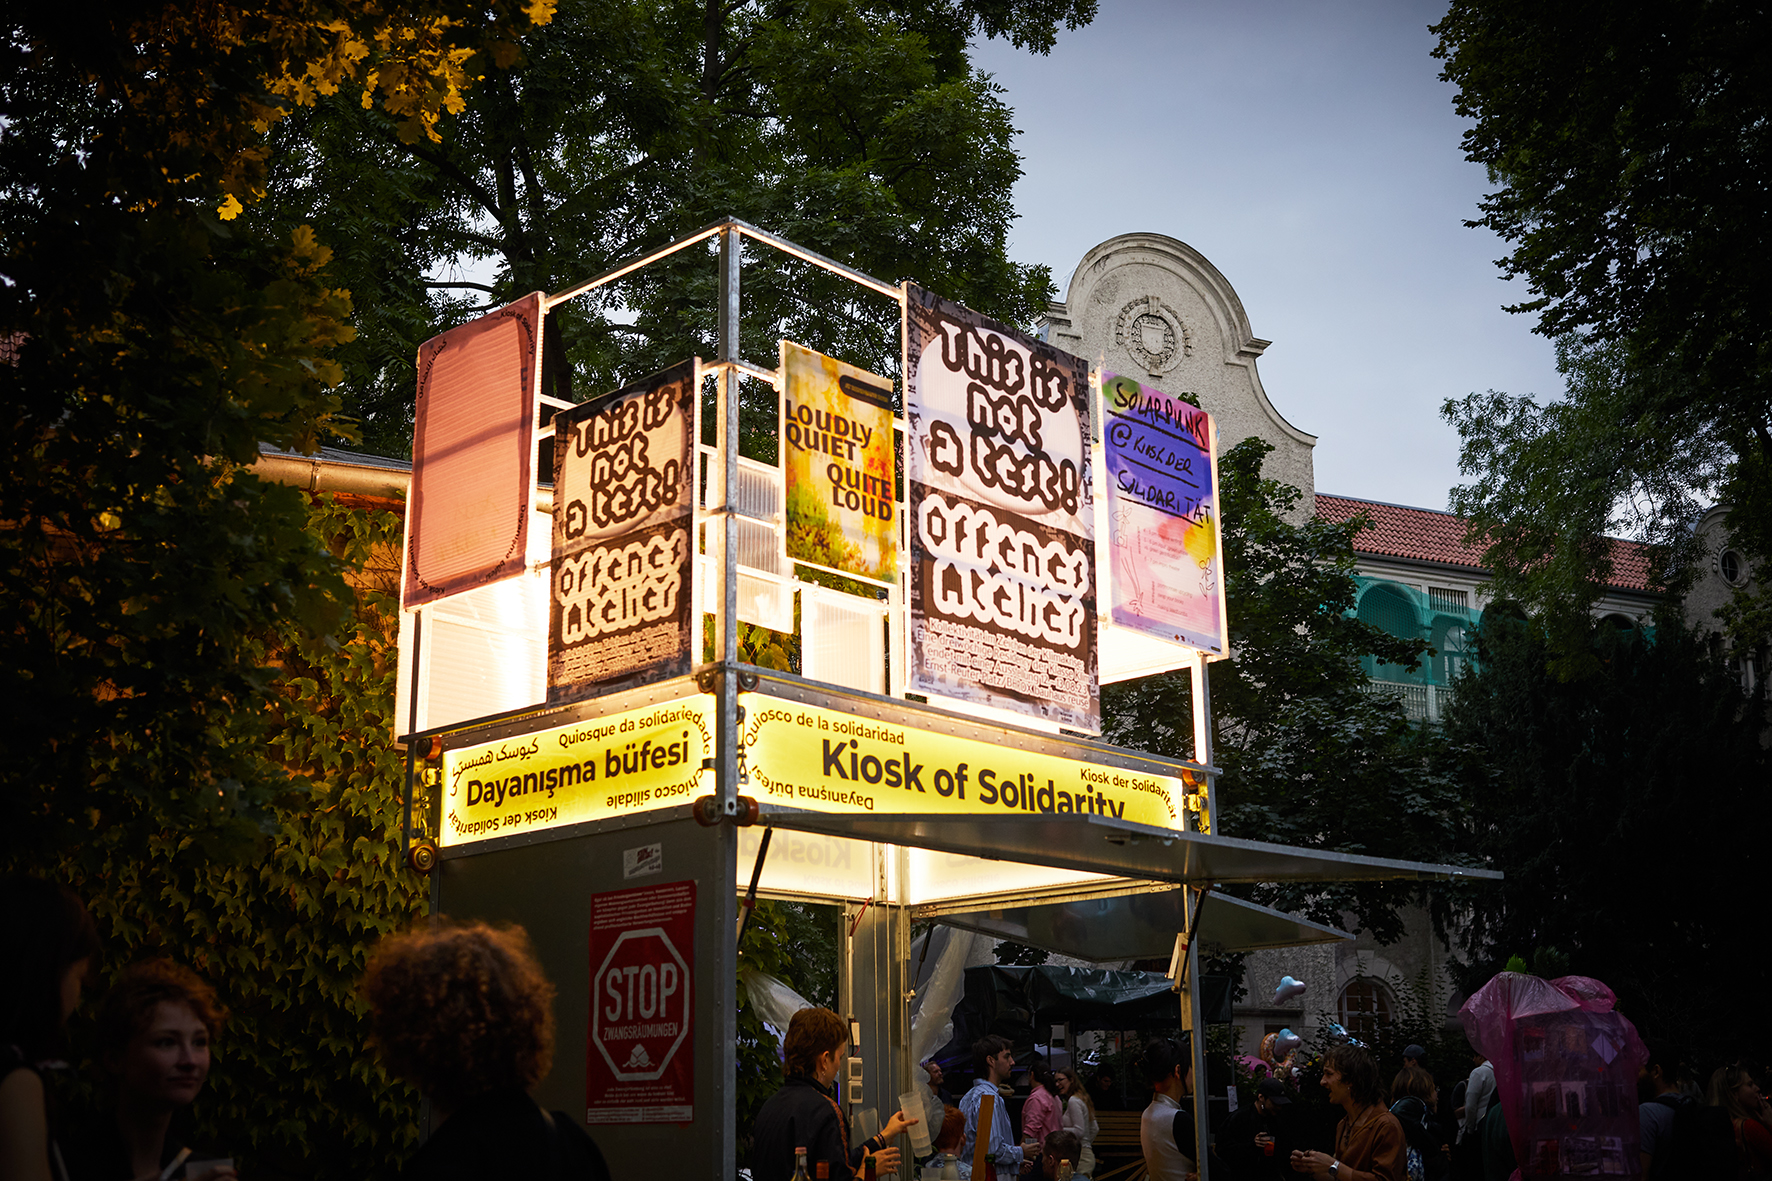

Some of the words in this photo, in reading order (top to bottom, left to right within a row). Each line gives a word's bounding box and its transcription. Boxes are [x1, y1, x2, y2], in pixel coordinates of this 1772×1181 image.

[937, 318, 1023, 392] This
[1030, 354, 1066, 411] is
[576, 401, 639, 457] This
[644, 387, 675, 431] is
[968, 384, 1041, 450] not
[1114, 382, 1206, 446] SOLARPUNK
[592, 433, 648, 488] not
[785, 422, 856, 461] QUIET
[1110, 422, 1132, 448] @
[1165, 451, 1194, 476] DER
[826, 463, 893, 501] QUITE
[931, 421, 962, 476] a
[972, 431, 1077, 514] test!
[566, 500, 586, 539] a
[594, 460, 677, 527] test!
[832, 485, 893, 522] LOUD
[565, 578, 678, 635] Atelier
[939, 560, 1081, 640] Atelier
[917, 629, 938, 644] Eine
[939, 634, 993, 656] dreiwöchige
[1032, 658, 1047, 671] der
[1048, 663, 1074, 679] Klasse
[1075, 670, 1094, 685] Klima
[928, 644, 954, 661] endet
[955, 654, 970, 664] mit
[972, 658, 994, 669] einer
[984, 633, 996, 643] im
[1028, 645, 1041, 657] der
[1034, 685, 1067, 703] bauhaus
[1067, 696, 1090, 708] reuse
[559, 725, 616, 748] Quiosque
[619, 719, 635, 733] da
[639, 705, 712, 755] solidariedade
[745, 709, 792, 747] Quiosco
[796, 712, 814, 727] de
[817, 715, 829, 731] la
[833, 721, 905, 745] solidaridad
[466, 759, 597, 808] Dayanışma
[604, 730, 690, 779] büfesi
[654, 767, 704, 799] chiosco
[749, 765, 794, 798] büfesi
[822, 738, 926, 794] Kiosk
[933, 762, 969, 798] of
[979, 768, 1126, 819] Solidarity
[1080, 768, 1110, 785] Kiosk
[1112, 774, 1130, 789] der
[1131, 778, 1177, 820] Solidarität
[447, 808, 500, 837] Solidarität
[502, 815, 522, 829] der
[524, 806, 558, 824] Kiosk
[606, 791, 651, 808] silidale
[798, 785, 874, 810] Dayanışma
[605, 962, 678, 1022] STOP
[603, 1022, 679, 1041] ZWANGSRÄUMUNGEN
